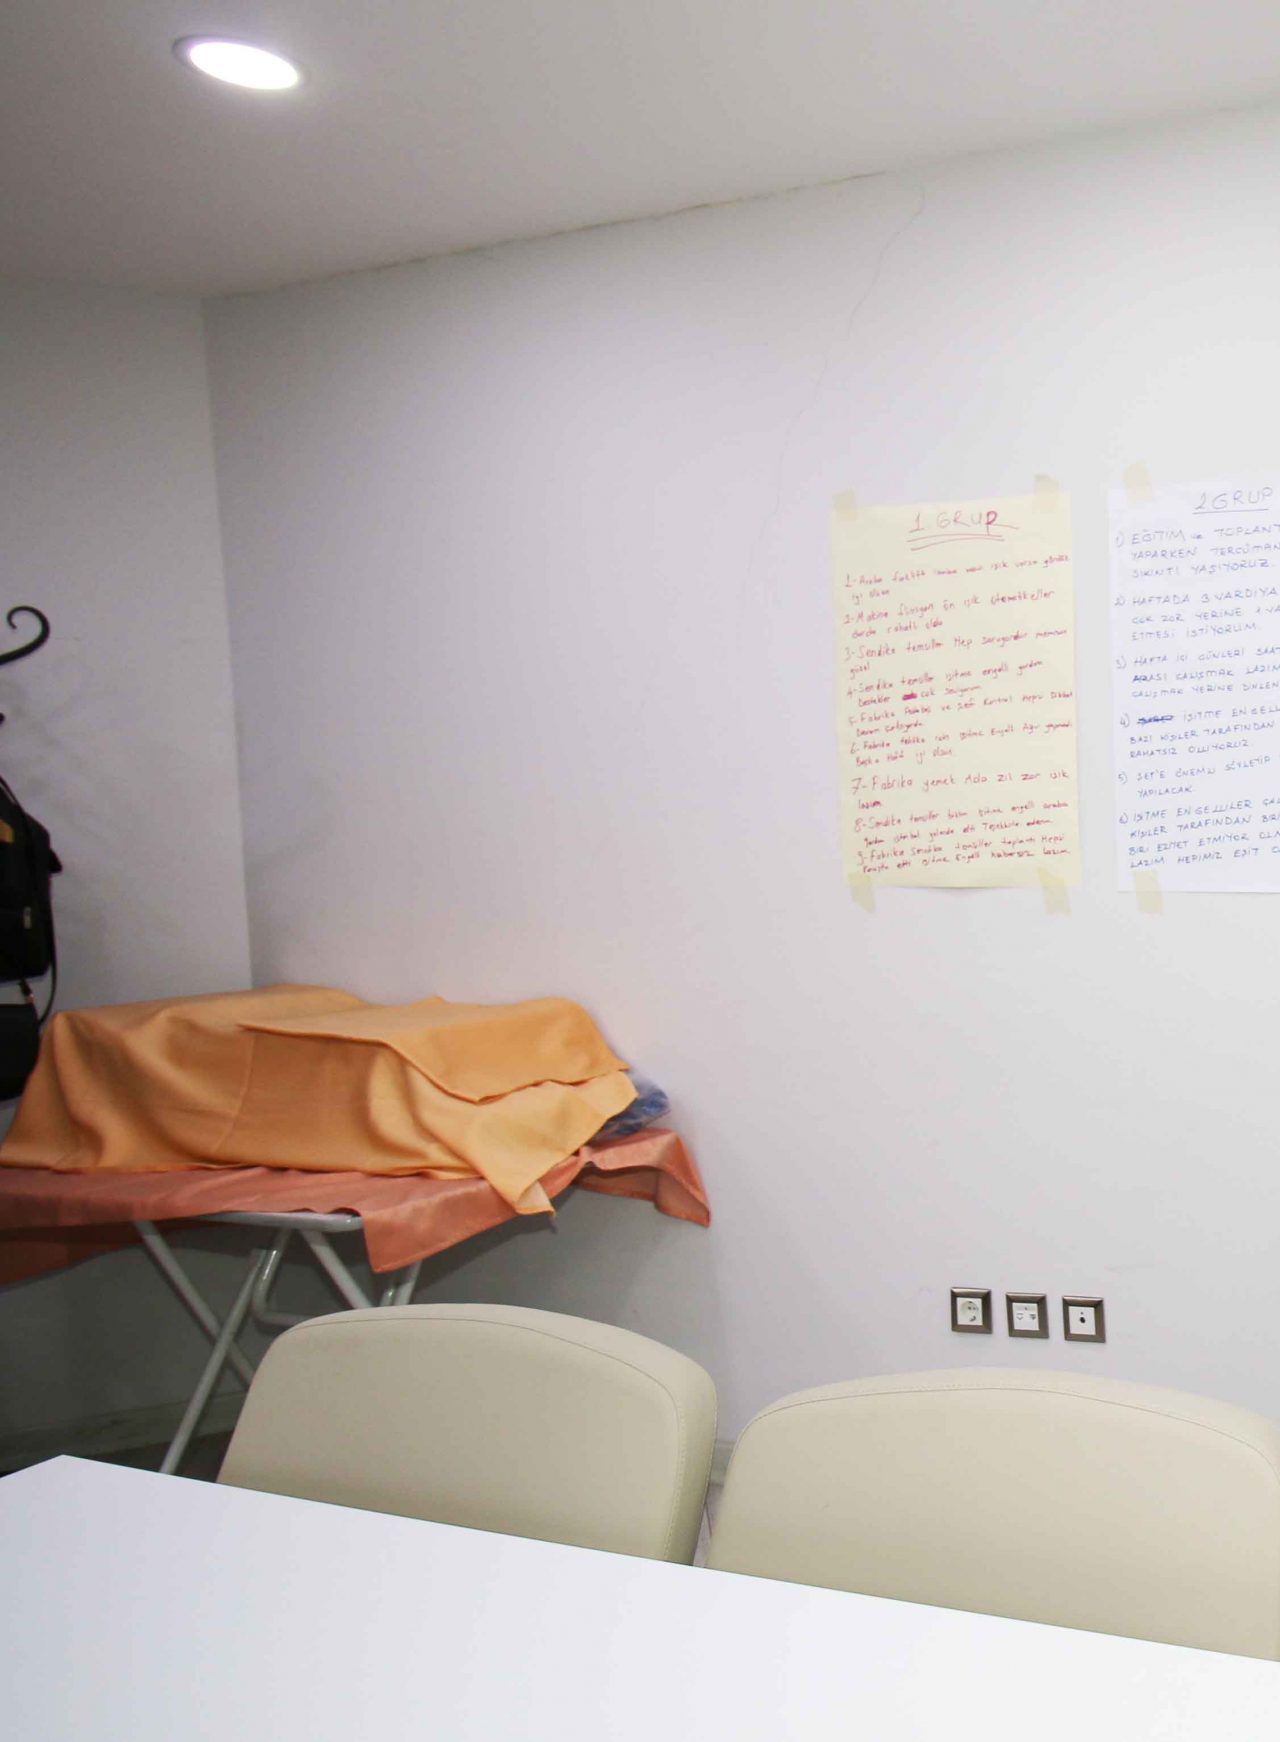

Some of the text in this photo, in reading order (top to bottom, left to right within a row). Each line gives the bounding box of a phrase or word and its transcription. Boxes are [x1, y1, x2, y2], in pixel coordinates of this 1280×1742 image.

[1212, 487, 1272, 510] GRUP
[909, 510, 1019, 537] 1 GRUP
[1132, 547, 1197, 560] YAPARKEN
[1133, 594, 1189, 606] HAFTADA
